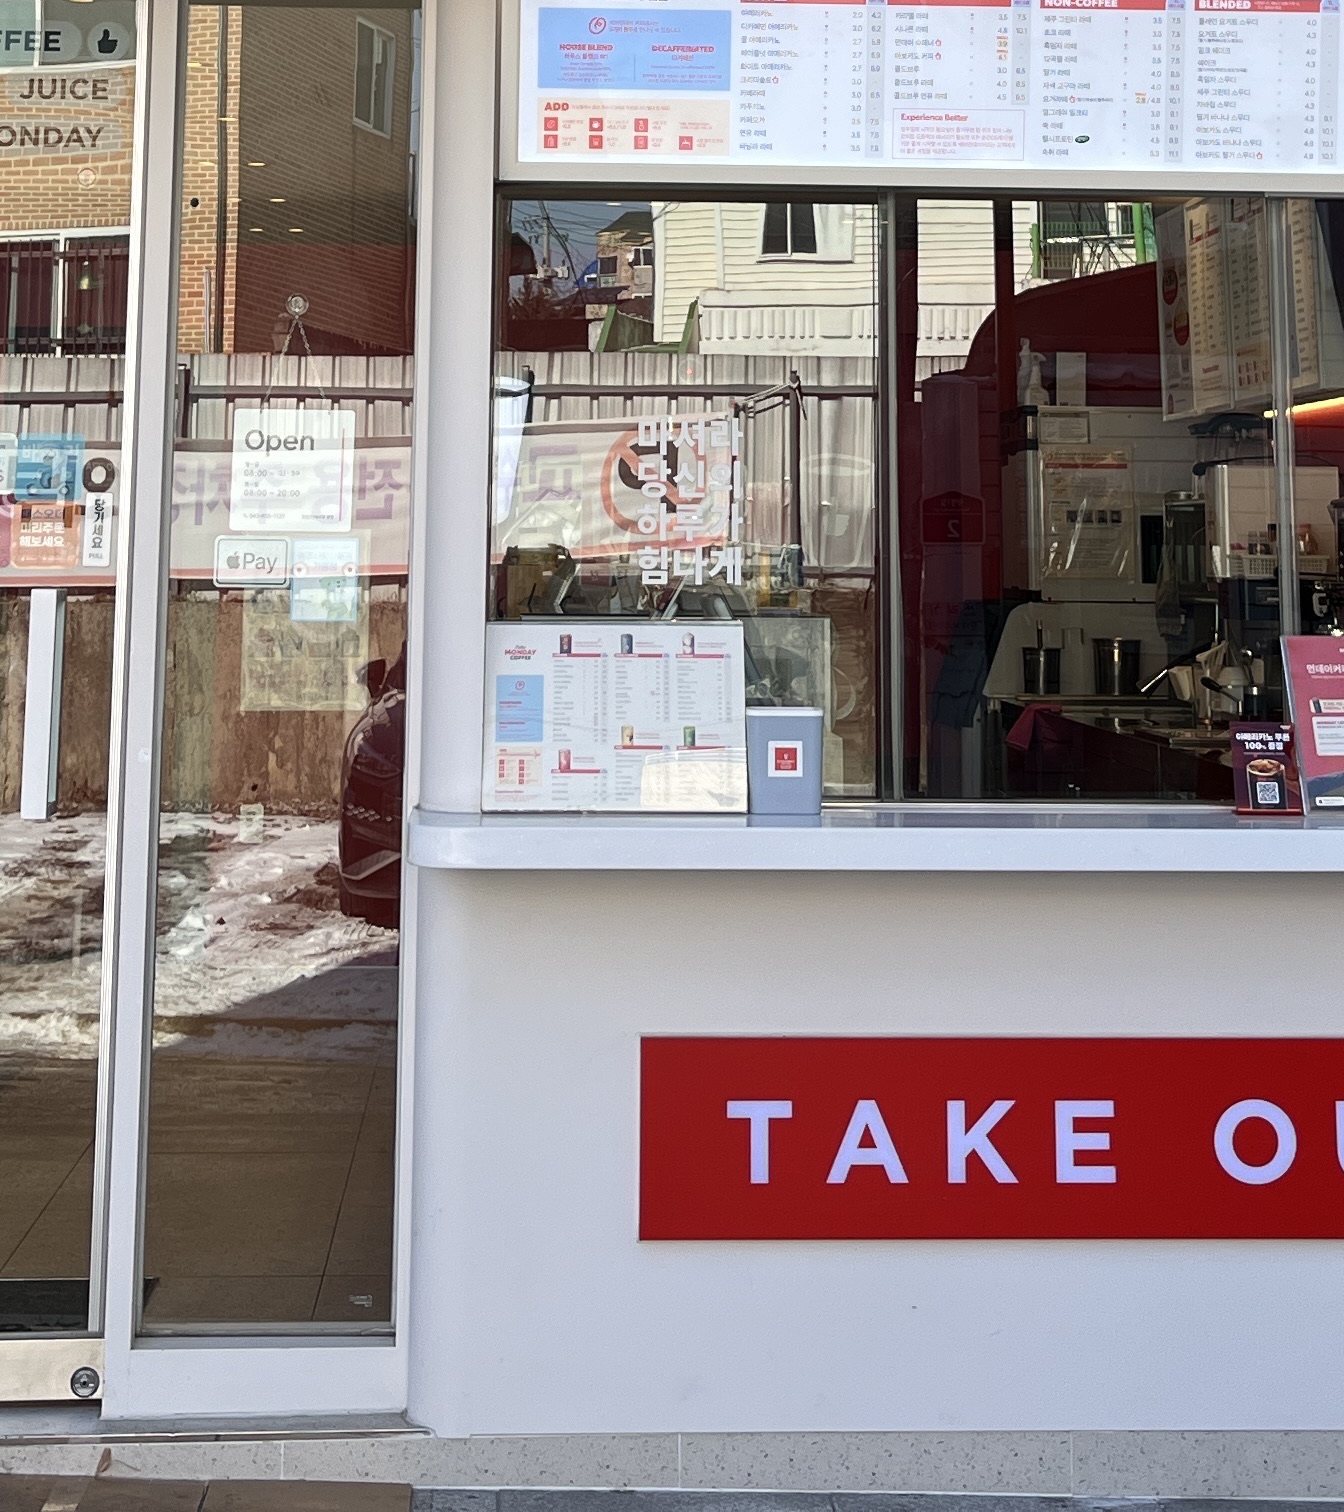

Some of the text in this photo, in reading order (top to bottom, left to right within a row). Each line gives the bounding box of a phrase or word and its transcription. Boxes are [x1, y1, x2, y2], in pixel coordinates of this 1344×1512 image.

[1199, 0, 1251, 9] BLENDED
[20, 78, 109, 100] JUICE
[544, 102, 569, 111] ADD
[244, 429, 315, 456] Open
[637, 417, 743, 456] 마셔라
[637, 459, 743, 499] 당신의
[20, 522, 65, 534] 미리주문
[92, 498, 106, 549] 당기세요
[637, 502, 743, 541] 하루가
[19, 536, 64, 547] 해보세요
[243, 553, 277, 574] Pay
[637, 545, 742, 586] 힘나게
[725, 1098, 1118, 1186] TAKE
